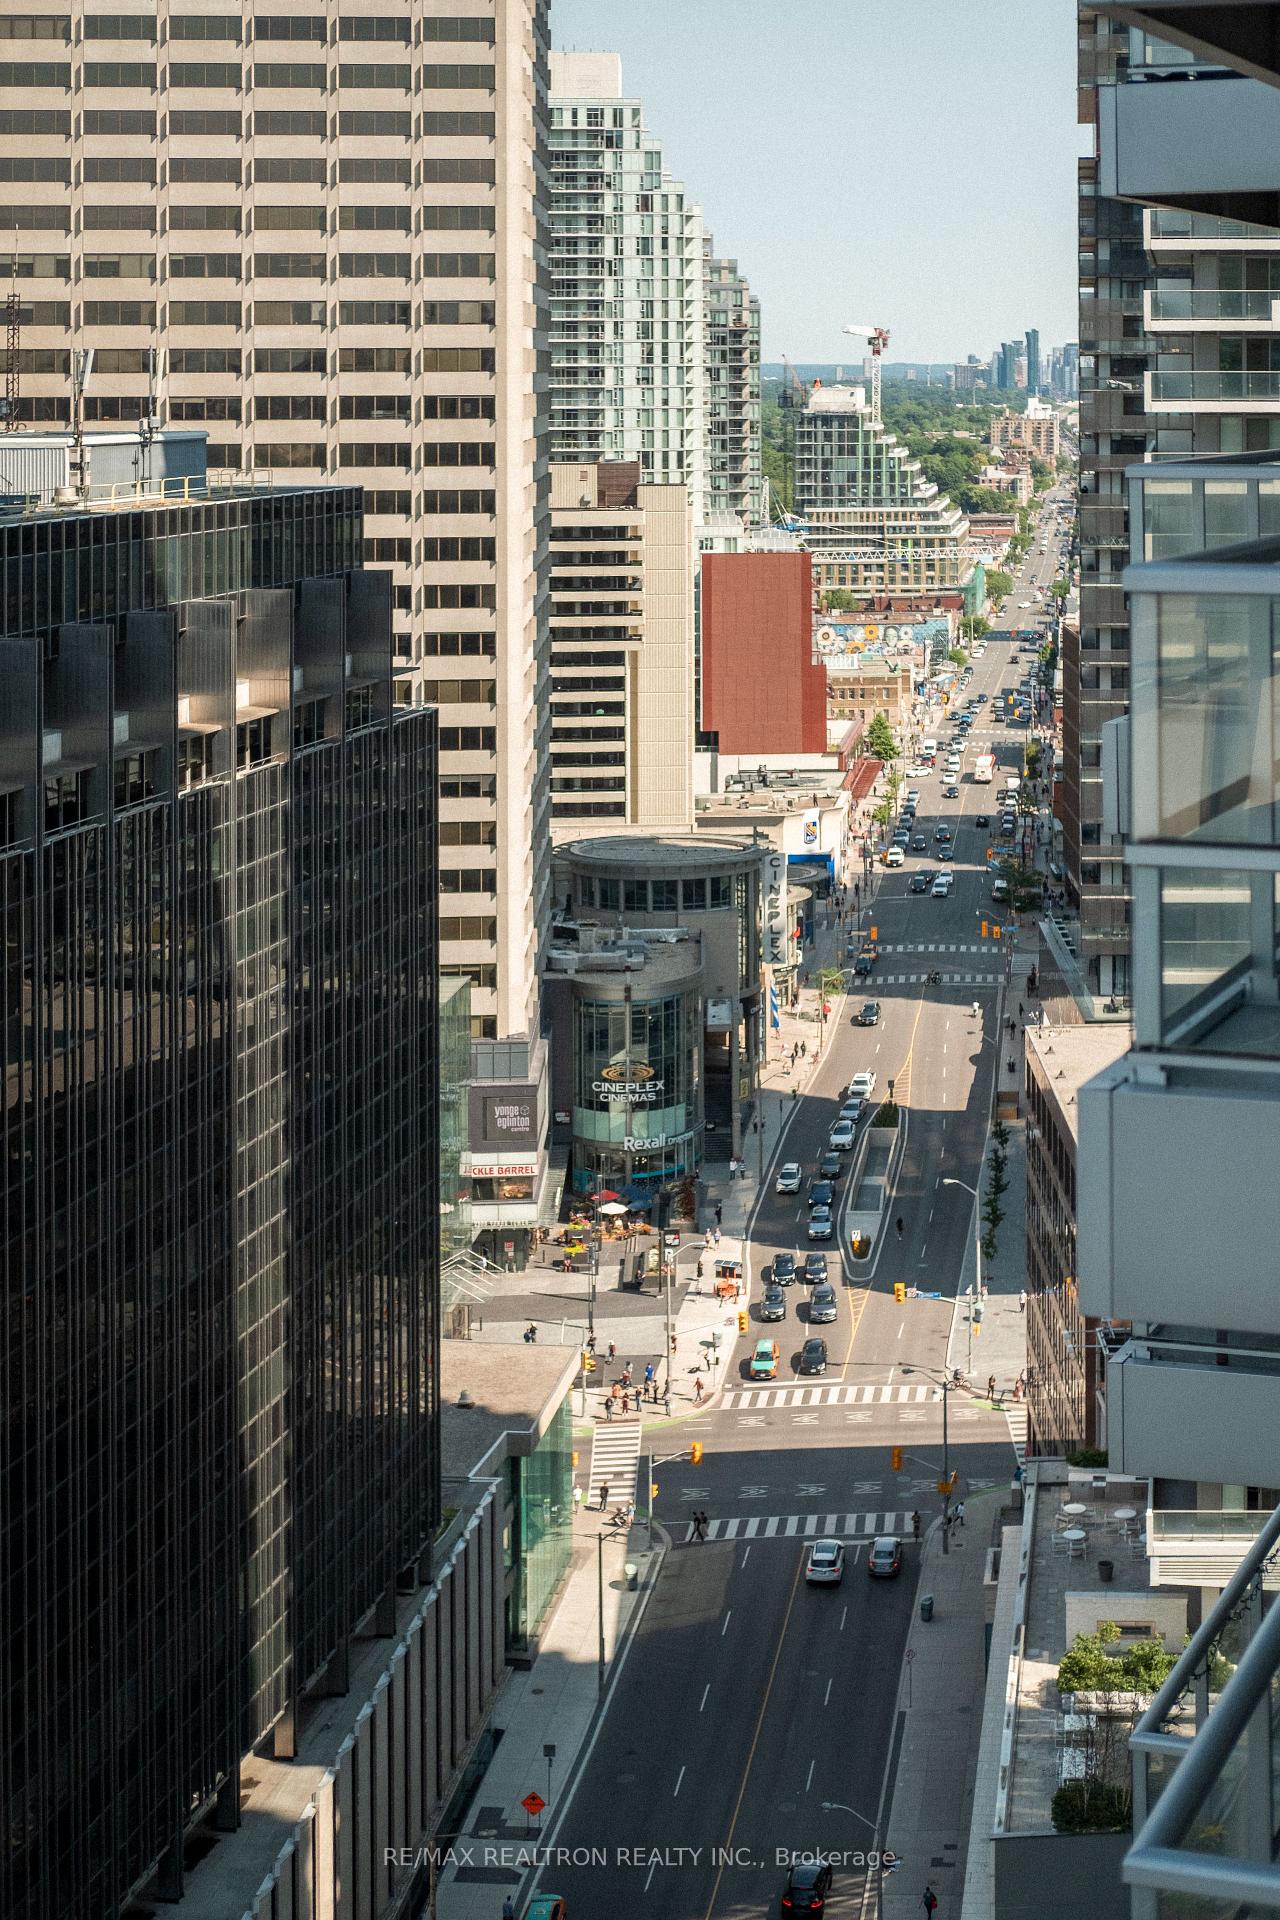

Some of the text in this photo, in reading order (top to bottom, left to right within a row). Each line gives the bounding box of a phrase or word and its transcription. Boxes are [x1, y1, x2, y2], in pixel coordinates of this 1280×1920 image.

[769, 857, 781, 963] CINEPLEX
[592, 1080, 665, 1093] CINEPLEX
[600, 1092, 657, 1102] CINEMAS
[494, 1105, 519, 1118] yonge
[497, 1116, 530, 1129] eglinton
[624, 1133, 666, 1152] Rexall
[472, 1166, 495, 1176] CKLE
[497, 1165, 535, 1175] BARREL
